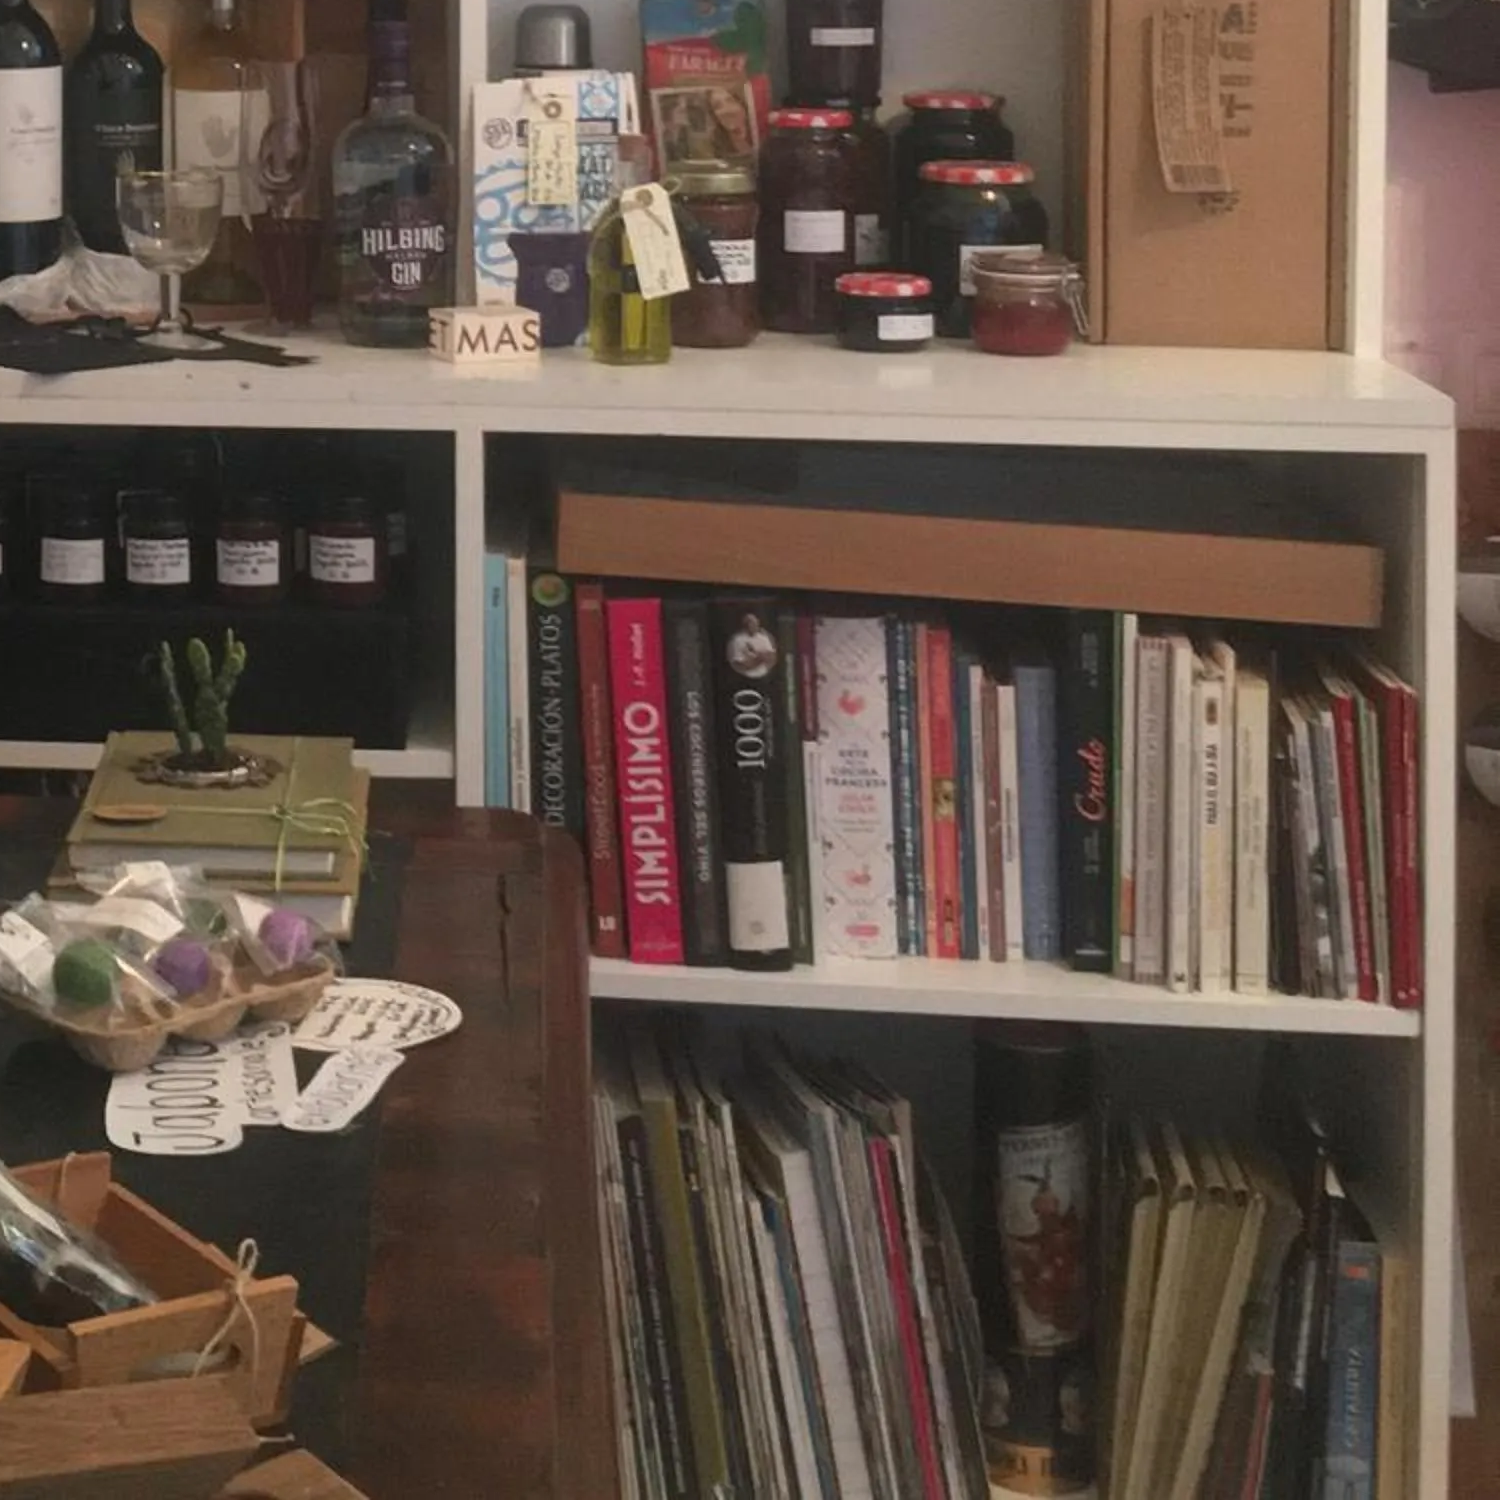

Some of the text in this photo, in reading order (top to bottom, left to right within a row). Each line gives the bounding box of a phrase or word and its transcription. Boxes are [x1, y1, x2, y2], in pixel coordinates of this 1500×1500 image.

[362, 224, 445, 257] HILBING
[390, 261, 422, 285] GIN
[457, 319, 541, 355] MAS
[534, 612, 566, 828] DECORACIÓN PLATOS
[732, 688, 766, 769] 1000
[622, 700, 671, 906] SIMPLÍSIMO
[1074, 736, 1108, 822] Crudo
